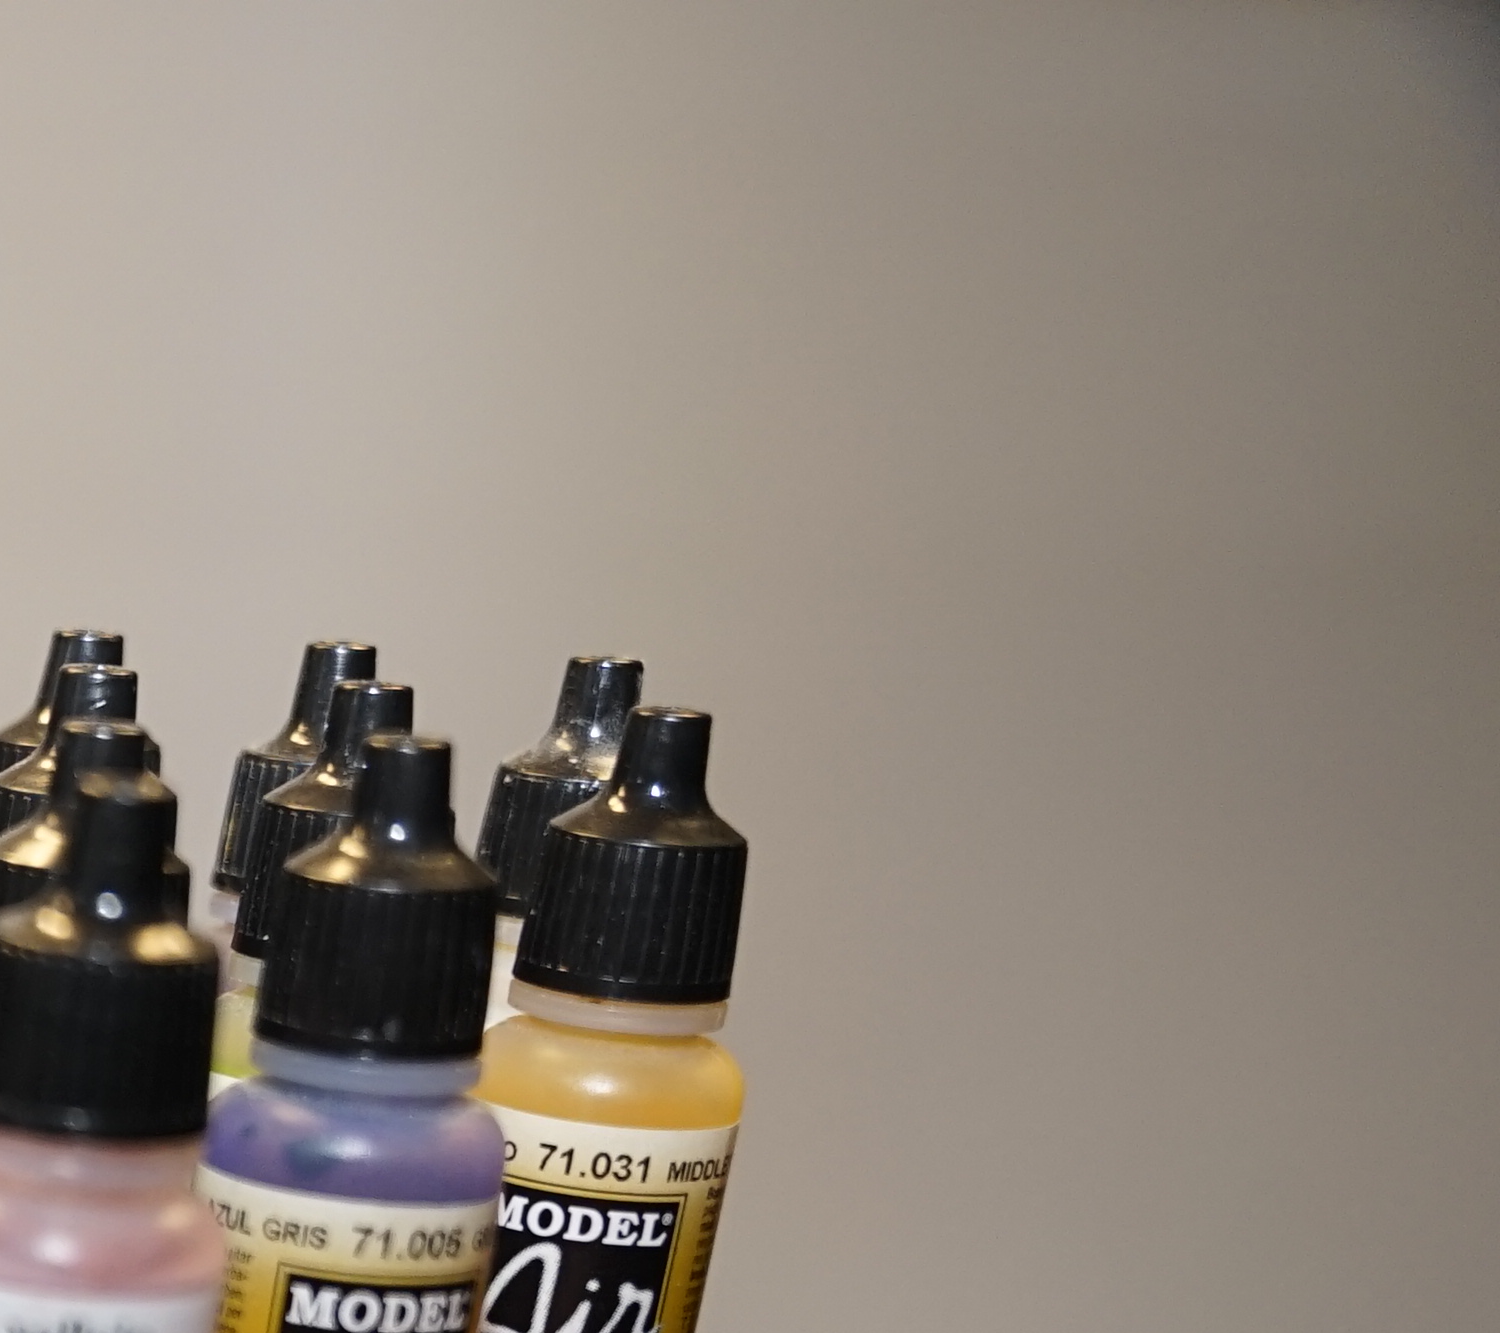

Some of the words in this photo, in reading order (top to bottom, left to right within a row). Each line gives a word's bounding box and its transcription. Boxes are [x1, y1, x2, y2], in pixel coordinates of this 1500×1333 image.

[537, 1142, 651, 1184] 71.031
[262, 1217, 329, 1252] GRIS
[351, 1224, 461, 1261] 71.005
